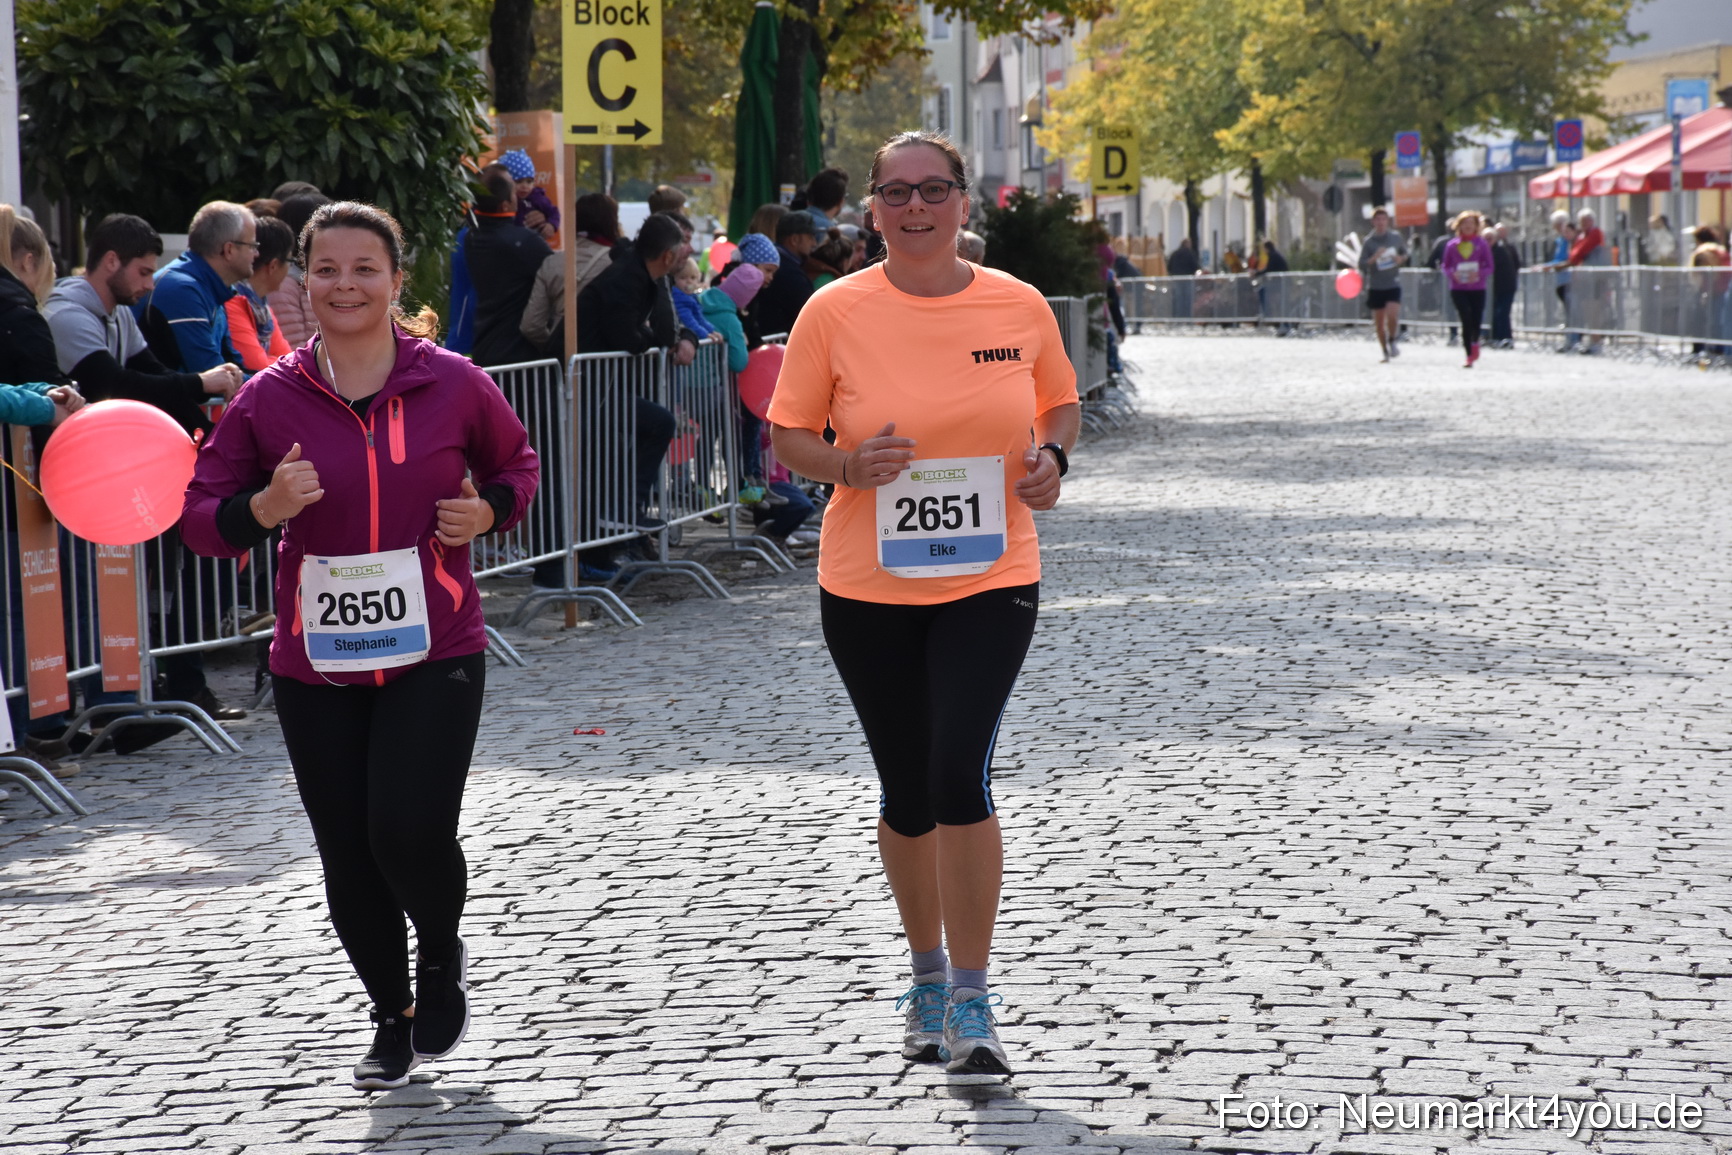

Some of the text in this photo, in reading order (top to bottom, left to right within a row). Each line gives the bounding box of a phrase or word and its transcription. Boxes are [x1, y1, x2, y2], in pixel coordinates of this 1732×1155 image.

[575, 0, 650, 25] Block
[587, 37, 637, 112] C
[1097, 127, 1134, 140] Block
[1105, 145, 1127, 179] D
[971, 348, 1021, 363] THULE
[924, 468, 966, 480] BOCK
[895, 493, 980, 532] 2651
[930, 544, 956, 557] Elke
[341, 563, 384, 577] BOCK
[317, 587, 406, 626] 2650
[334, 635, 397, 653] Stephanie
